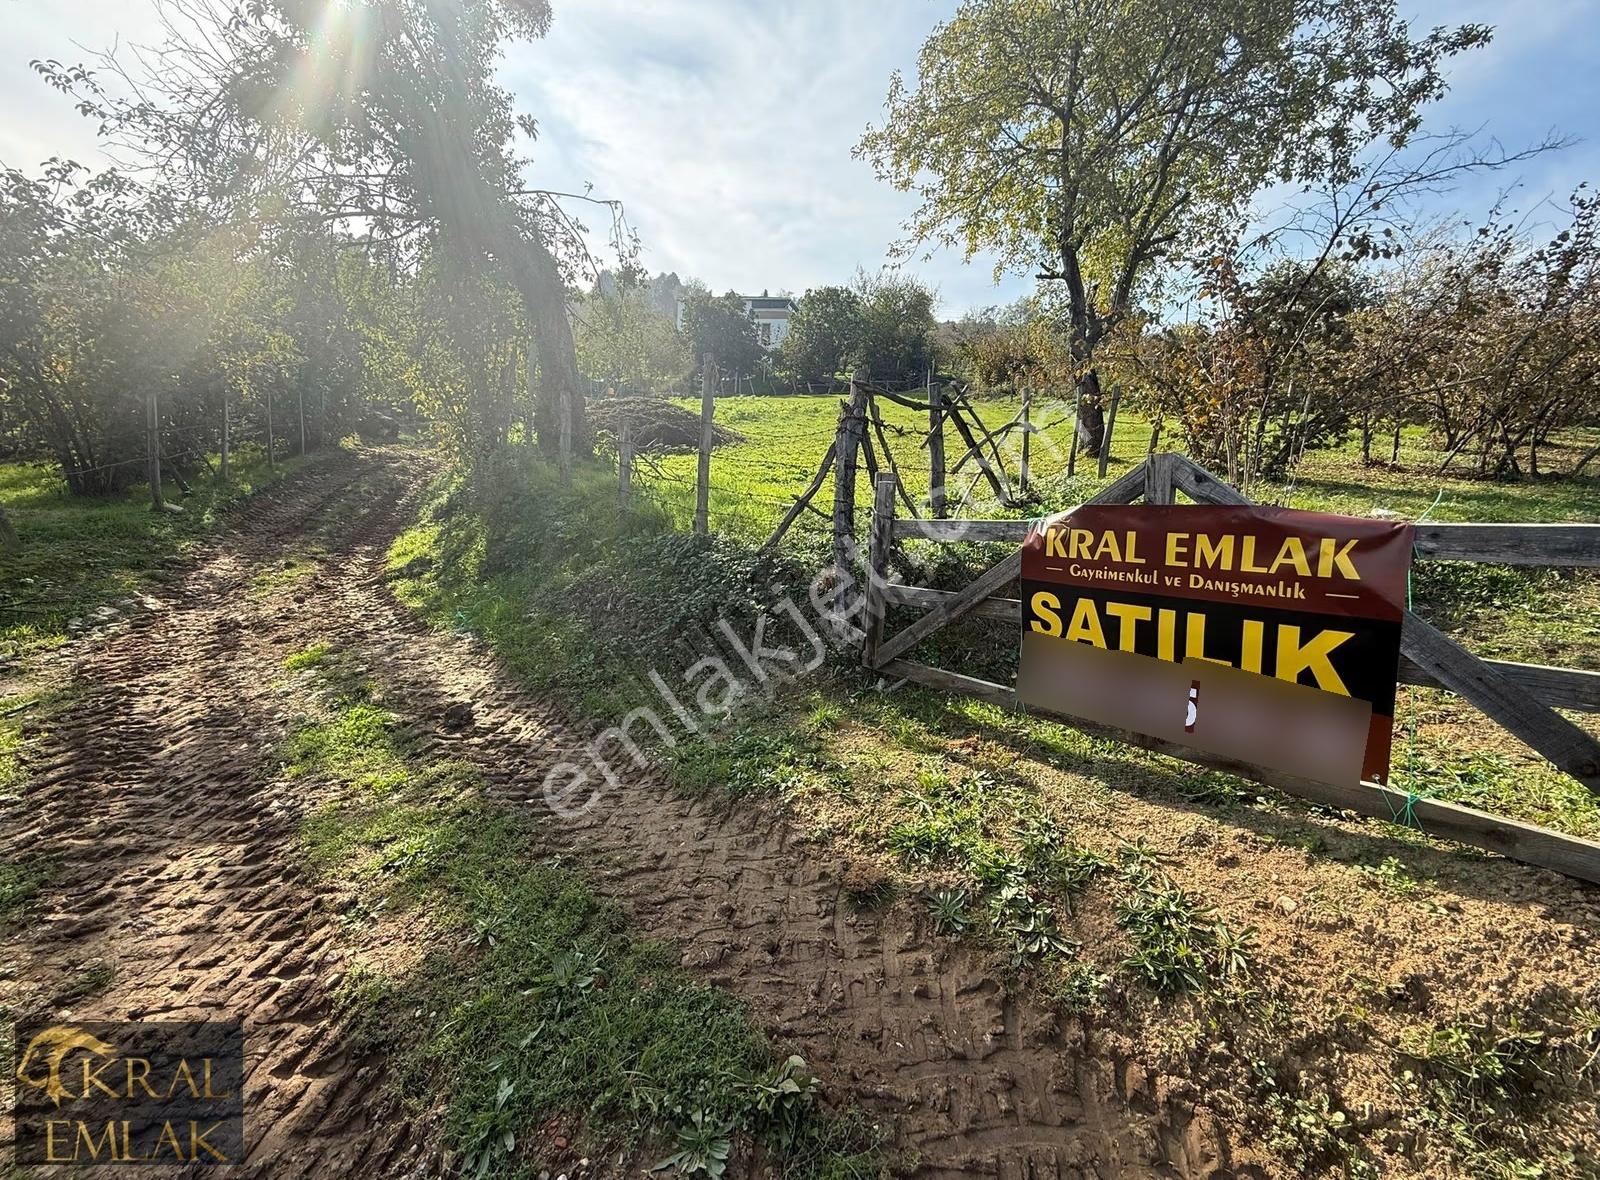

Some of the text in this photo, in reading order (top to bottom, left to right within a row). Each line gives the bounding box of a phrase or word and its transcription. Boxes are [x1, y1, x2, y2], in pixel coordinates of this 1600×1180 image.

[1045, 527, 1360, 580] KRAL EMLAK
[1029, 591, 1356, 698] SATILIK
